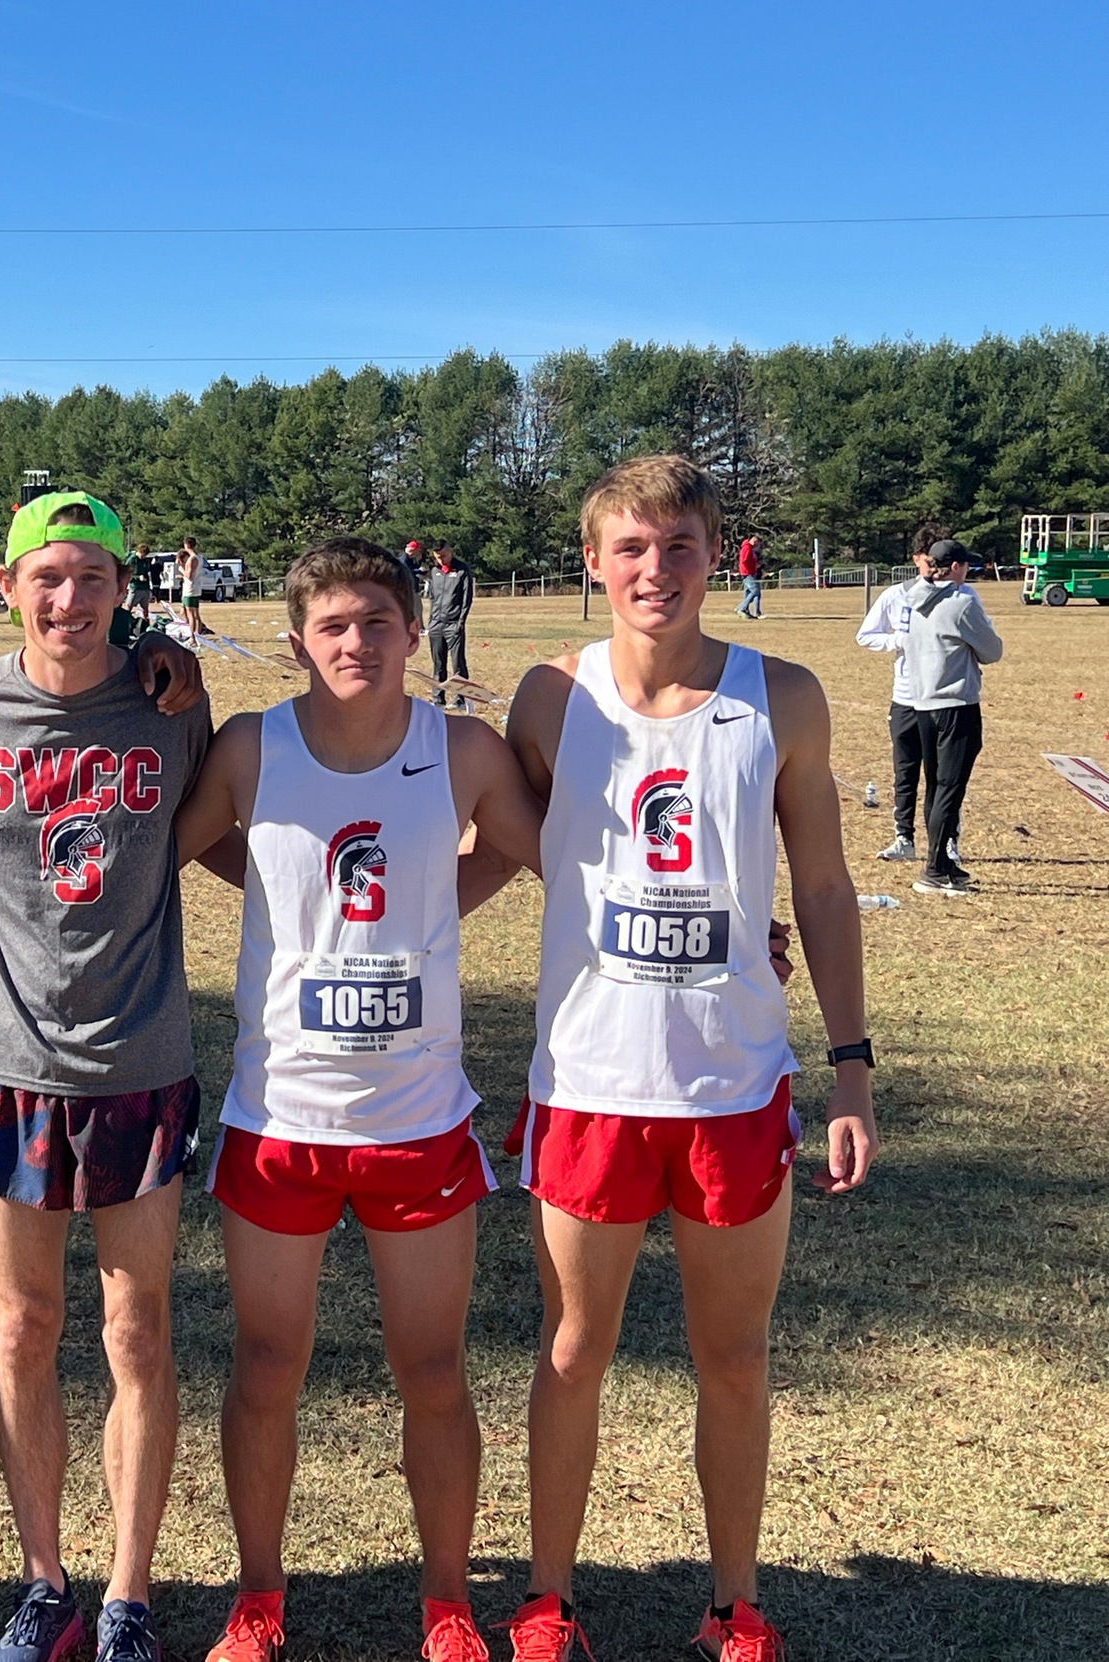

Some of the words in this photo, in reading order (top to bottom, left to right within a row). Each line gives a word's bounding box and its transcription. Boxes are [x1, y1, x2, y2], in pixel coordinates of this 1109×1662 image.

[643, 886, 671, 898] NJCAA
[672, 887, 710, 897] National
[640, 897, 712, 909] Championships
[614, 911, 711, 959] 1058
[344, 957, 370, 967] NJCAA
[372, 958, 406, 968] National
[627, 962, 664, 974] November
[674, 966, 692, 974] 2024
[342, 969, 408, 979] Championships
[634, 972, 674, 984] Richmond,
[315, 985, 409, 1028] 1055
[332, 1034, 369, 1042] November
